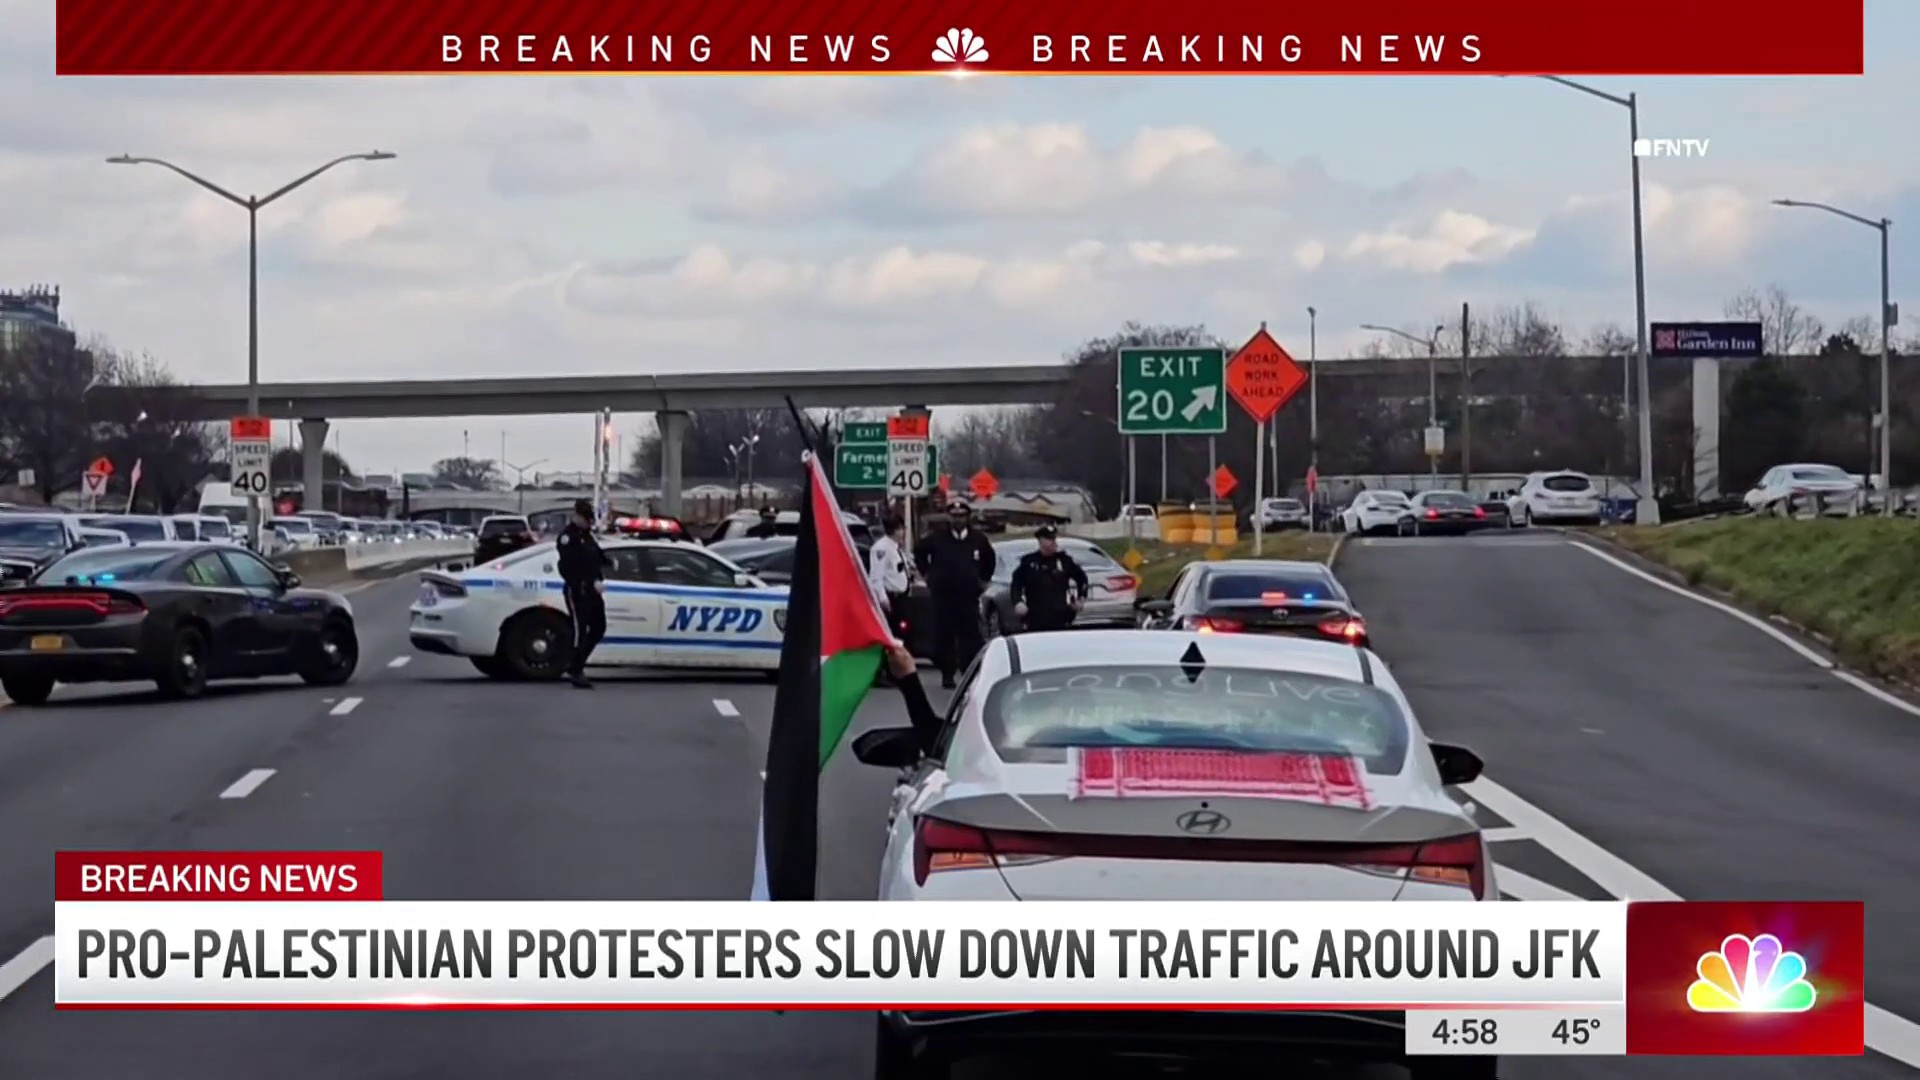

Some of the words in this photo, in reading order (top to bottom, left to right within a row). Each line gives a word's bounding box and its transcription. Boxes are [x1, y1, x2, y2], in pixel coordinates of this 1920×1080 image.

[1676, 337, 1729, 350] Garden
[1730, 336, 1756, 350] Inn
[1244, 353, 1280, 365] ROAD
[1140, 356, 1202, 377] EXIT
[1245, 371, 1279, 382] WORK
[1242, 386, 1285, 398] AHEAD
[1127, 389, 1174, 421] 20
[855, 427, 881, 438] EXIT
[234, 444, 268, 455] SPEED
[891, 442, 924, 454] SPEED
[237, 458, 263, 467] LIMIT
[895, 456, 921, 466] LIMIT
[862, 465, 873, 479] 2
[233, 471, 267, 493] 40
[891, 469, 924, 491] 40
[667, 605, 763, 633] NYPD
